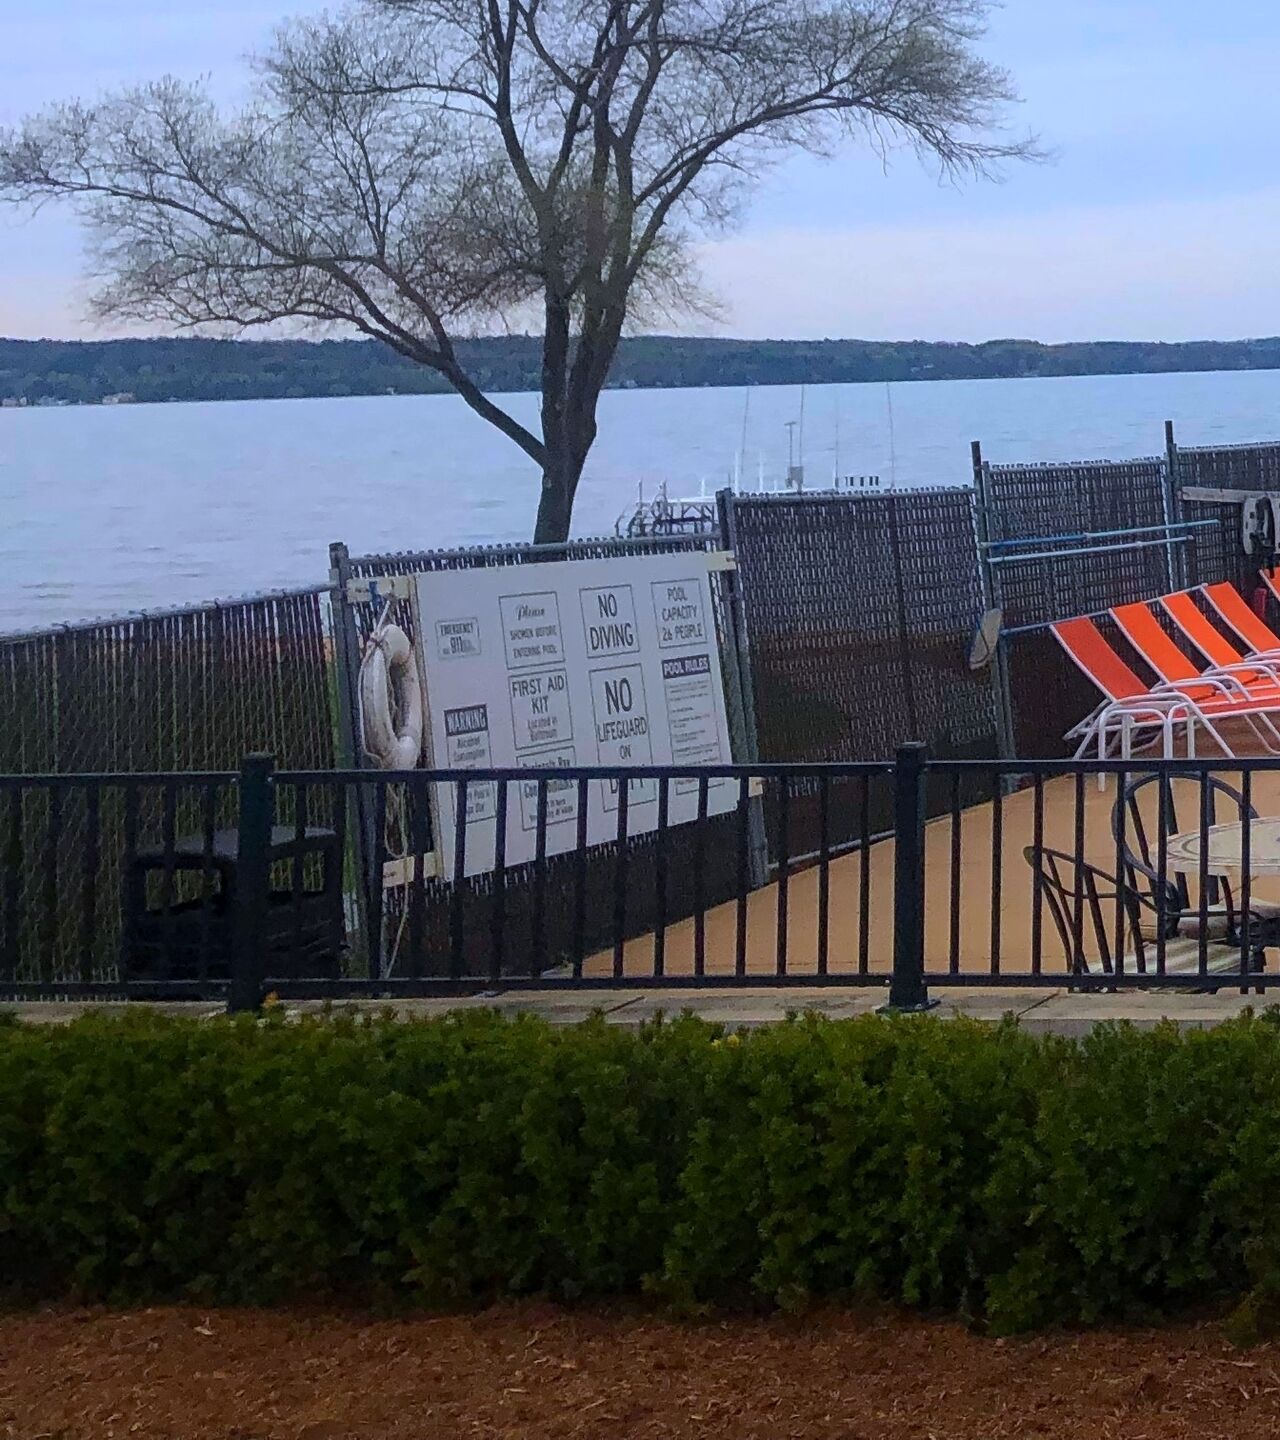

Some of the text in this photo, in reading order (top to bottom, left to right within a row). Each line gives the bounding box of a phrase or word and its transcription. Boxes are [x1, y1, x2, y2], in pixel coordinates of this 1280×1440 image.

[667, 586, 689, 602] POOL
[597, 593, 618, 618] NO
[661, 604, 698, 621] CAPACITY
[589, 622, 634, 651] DIVING
[662, 623, 704, 641] 26 PEOPLE
[663, 657, 709, 676] POOL RULES
[511, 674, 565, 698] FIRST AID
[604, 677, 633, 715] NO
[531, 695, 549, 714] KIT
[447, 708, 487, 733] WARNING
[597, 716, 648, 742] LIFEGUARD
[619, 744, 633, 760] ON
